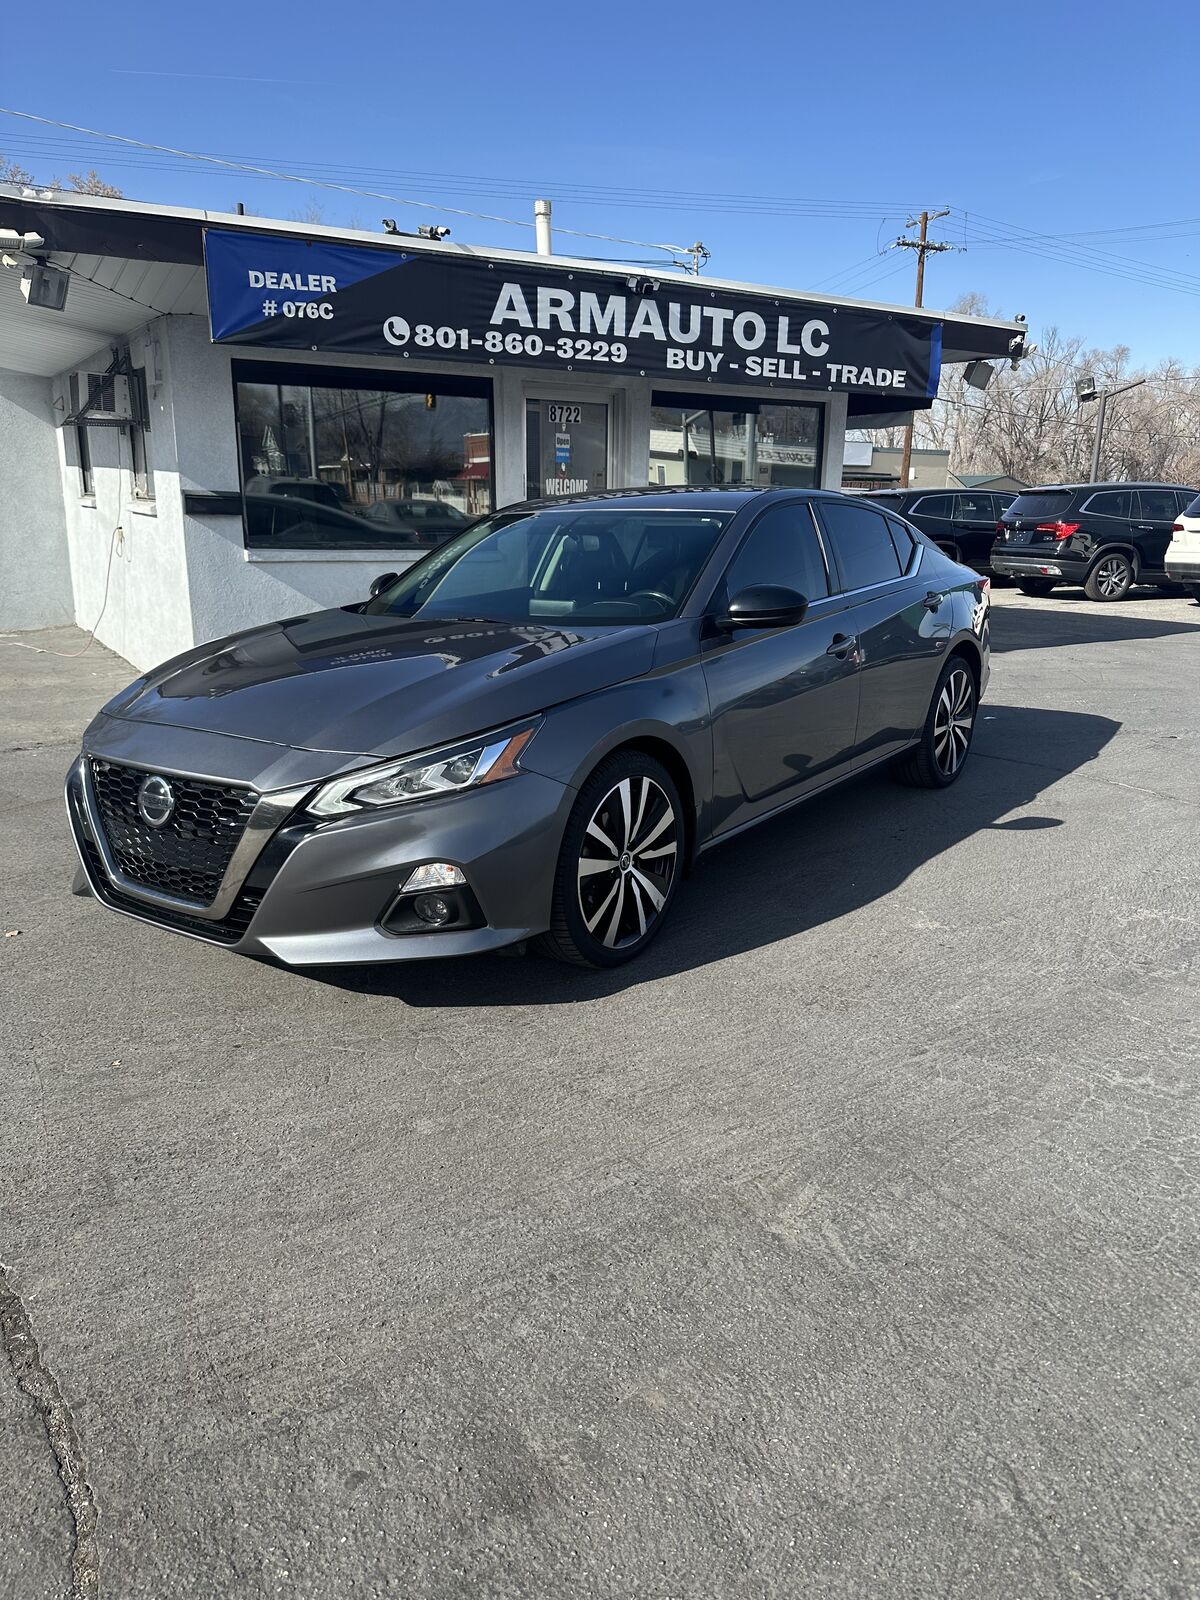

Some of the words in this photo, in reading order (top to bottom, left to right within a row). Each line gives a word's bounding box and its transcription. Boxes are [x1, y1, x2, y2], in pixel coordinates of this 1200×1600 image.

[249, 270, 338, 293] DEALER
[262, 300, 278, 317] #
[282, 301, 334, 320] 076C
[489, 282, 766, 351] ARMAUTO
[776, 315, 830, 358] LC
[414, 323, 628, 364] 801-860-3229
[666, 348, 724, 373] BUY
[745, 356, 807, 380] SELL
[826, 363, 906, 388] TRADE
[549, 405, 580, 423] 8722
[545, 478, 588, 496] WELCOME
